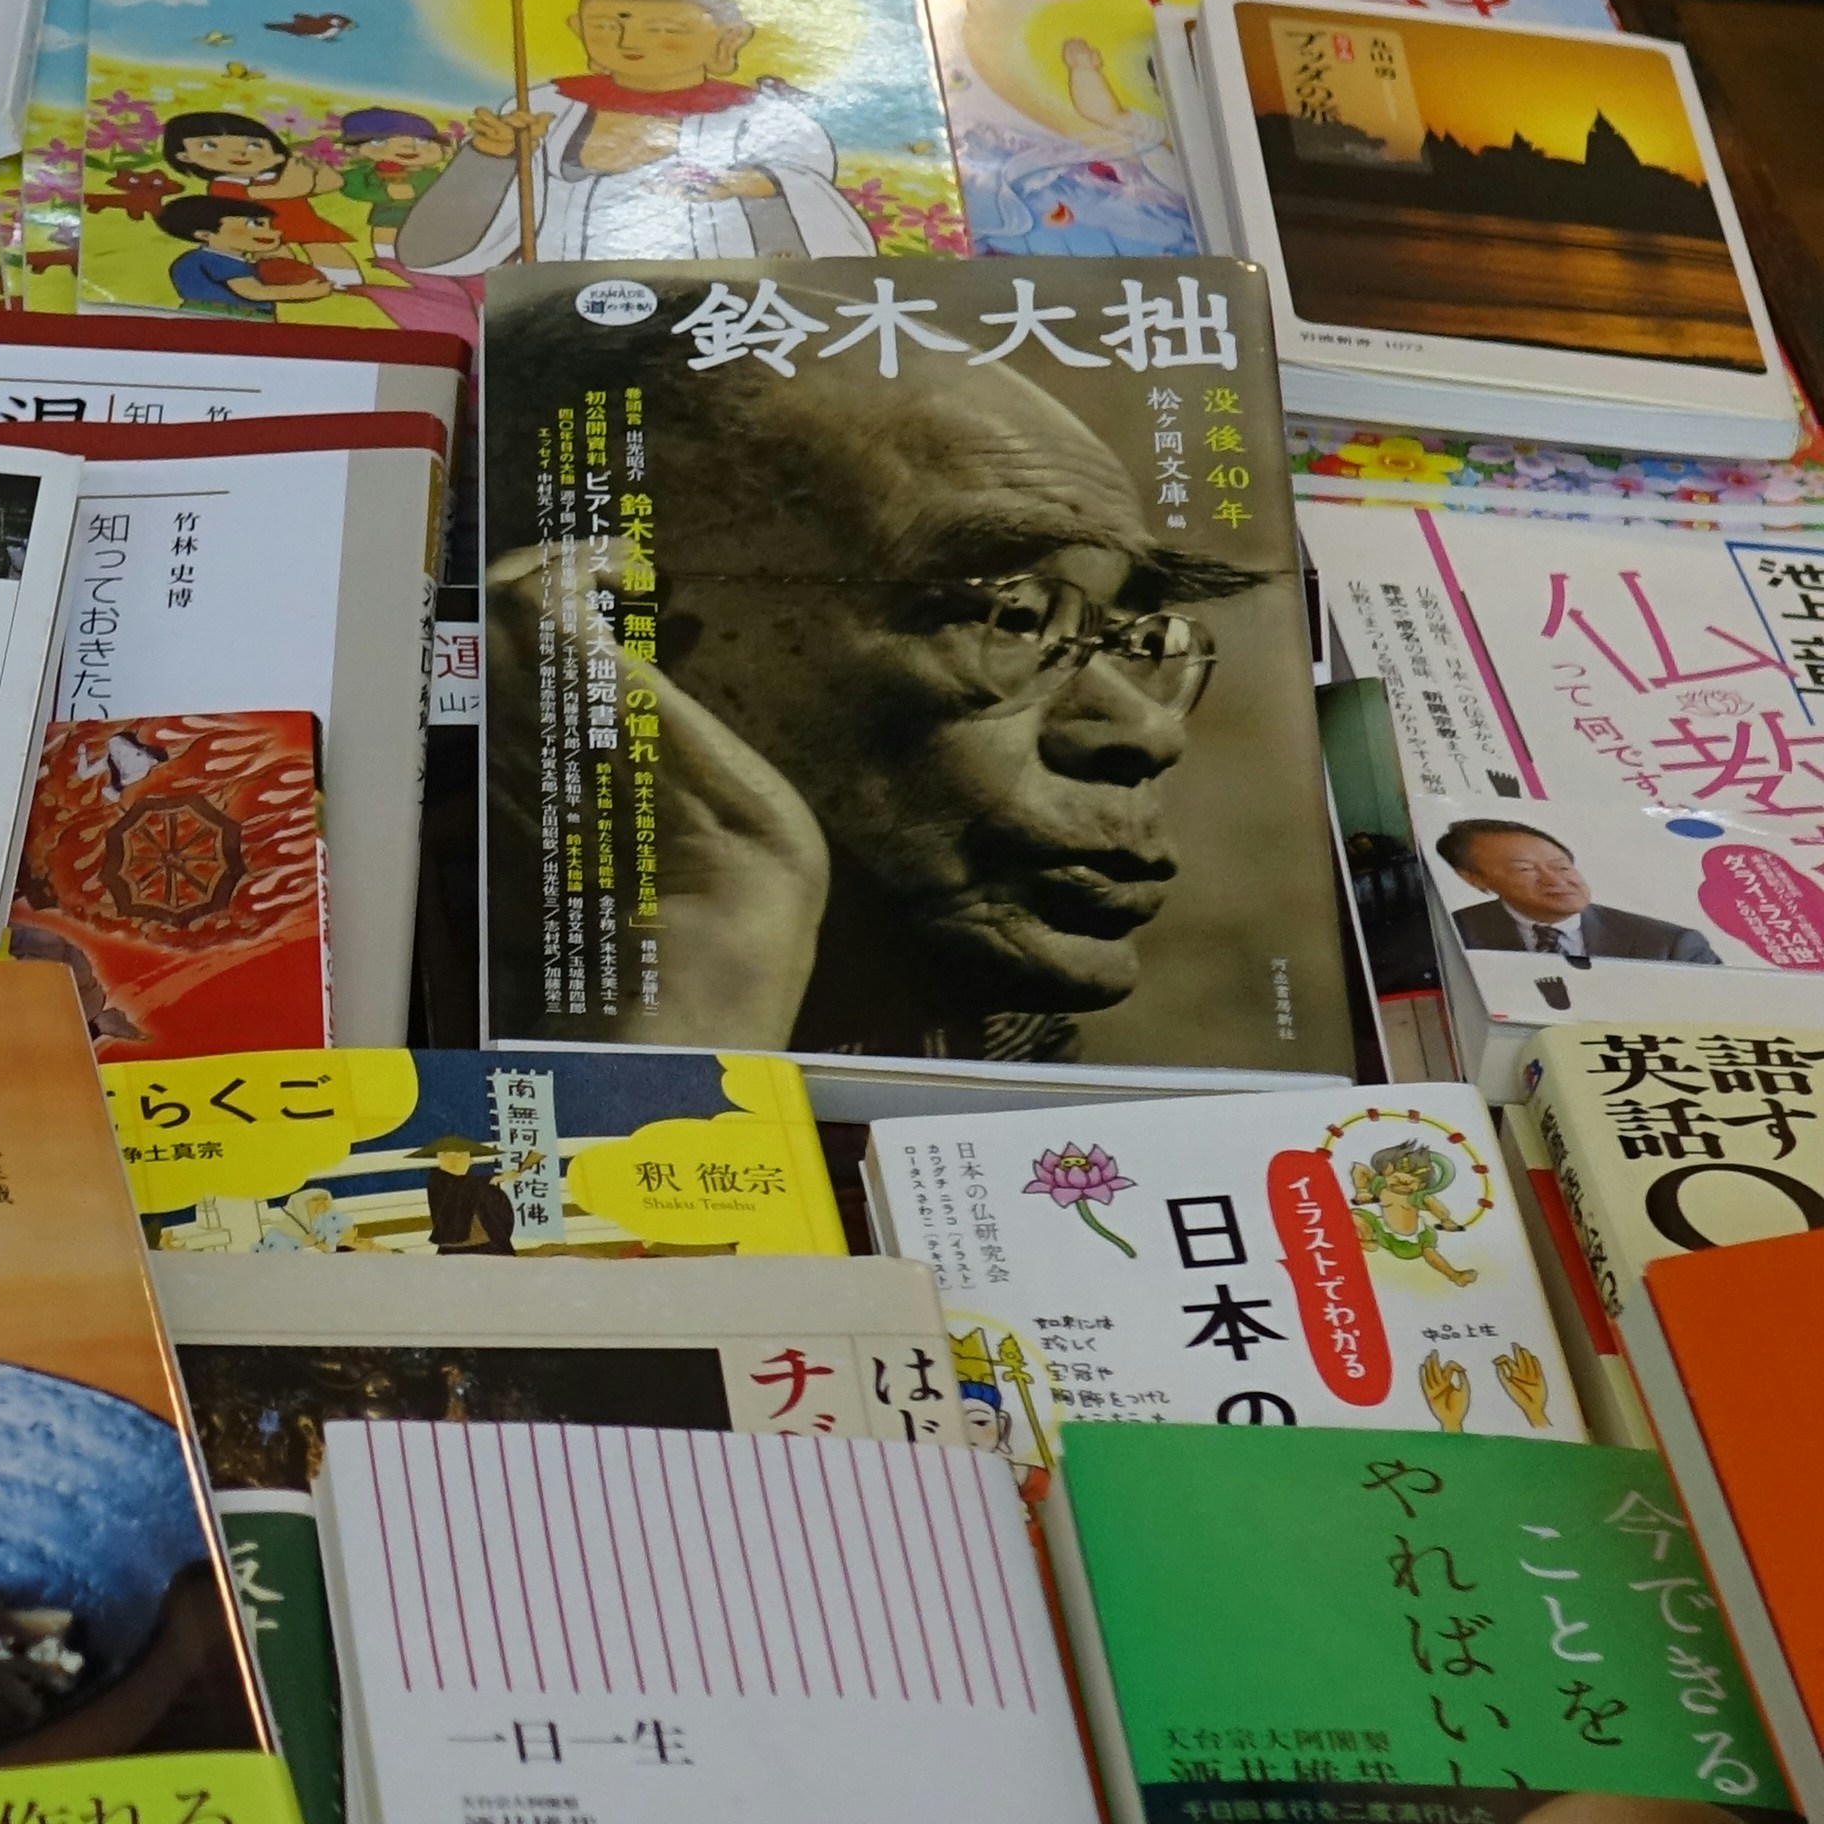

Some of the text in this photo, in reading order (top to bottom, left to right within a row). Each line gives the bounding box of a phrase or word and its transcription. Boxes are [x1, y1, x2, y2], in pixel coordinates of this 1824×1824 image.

[672, 276, 1240, 377] 鈴木大拙
[537, 427, 553, 470] エッセイ
[1202, 388, 1254, 530] 没後40年
[69, 512, 131, 721] 知っておきたい
[166, 511, 201, 610] 竹林史博
[105, 1075, 337, 1133] らくご
[633, 1159, 790, 1198] 釈 徹宗
[641, 1195, 758, 1213] Shaku Tesshu
[956, 1140, 1012, 1287] 日本の仏研究会
[1164, 1194, 1299, 1427] 日本の
[1284, 1174, 1367, 1382] イラストでわかる
[1518, 1521, 1631, 1750] ことを
[1601, 1488, 1760, 1797] 今できる
[446, 1717, 697, 1768] 一日一生
